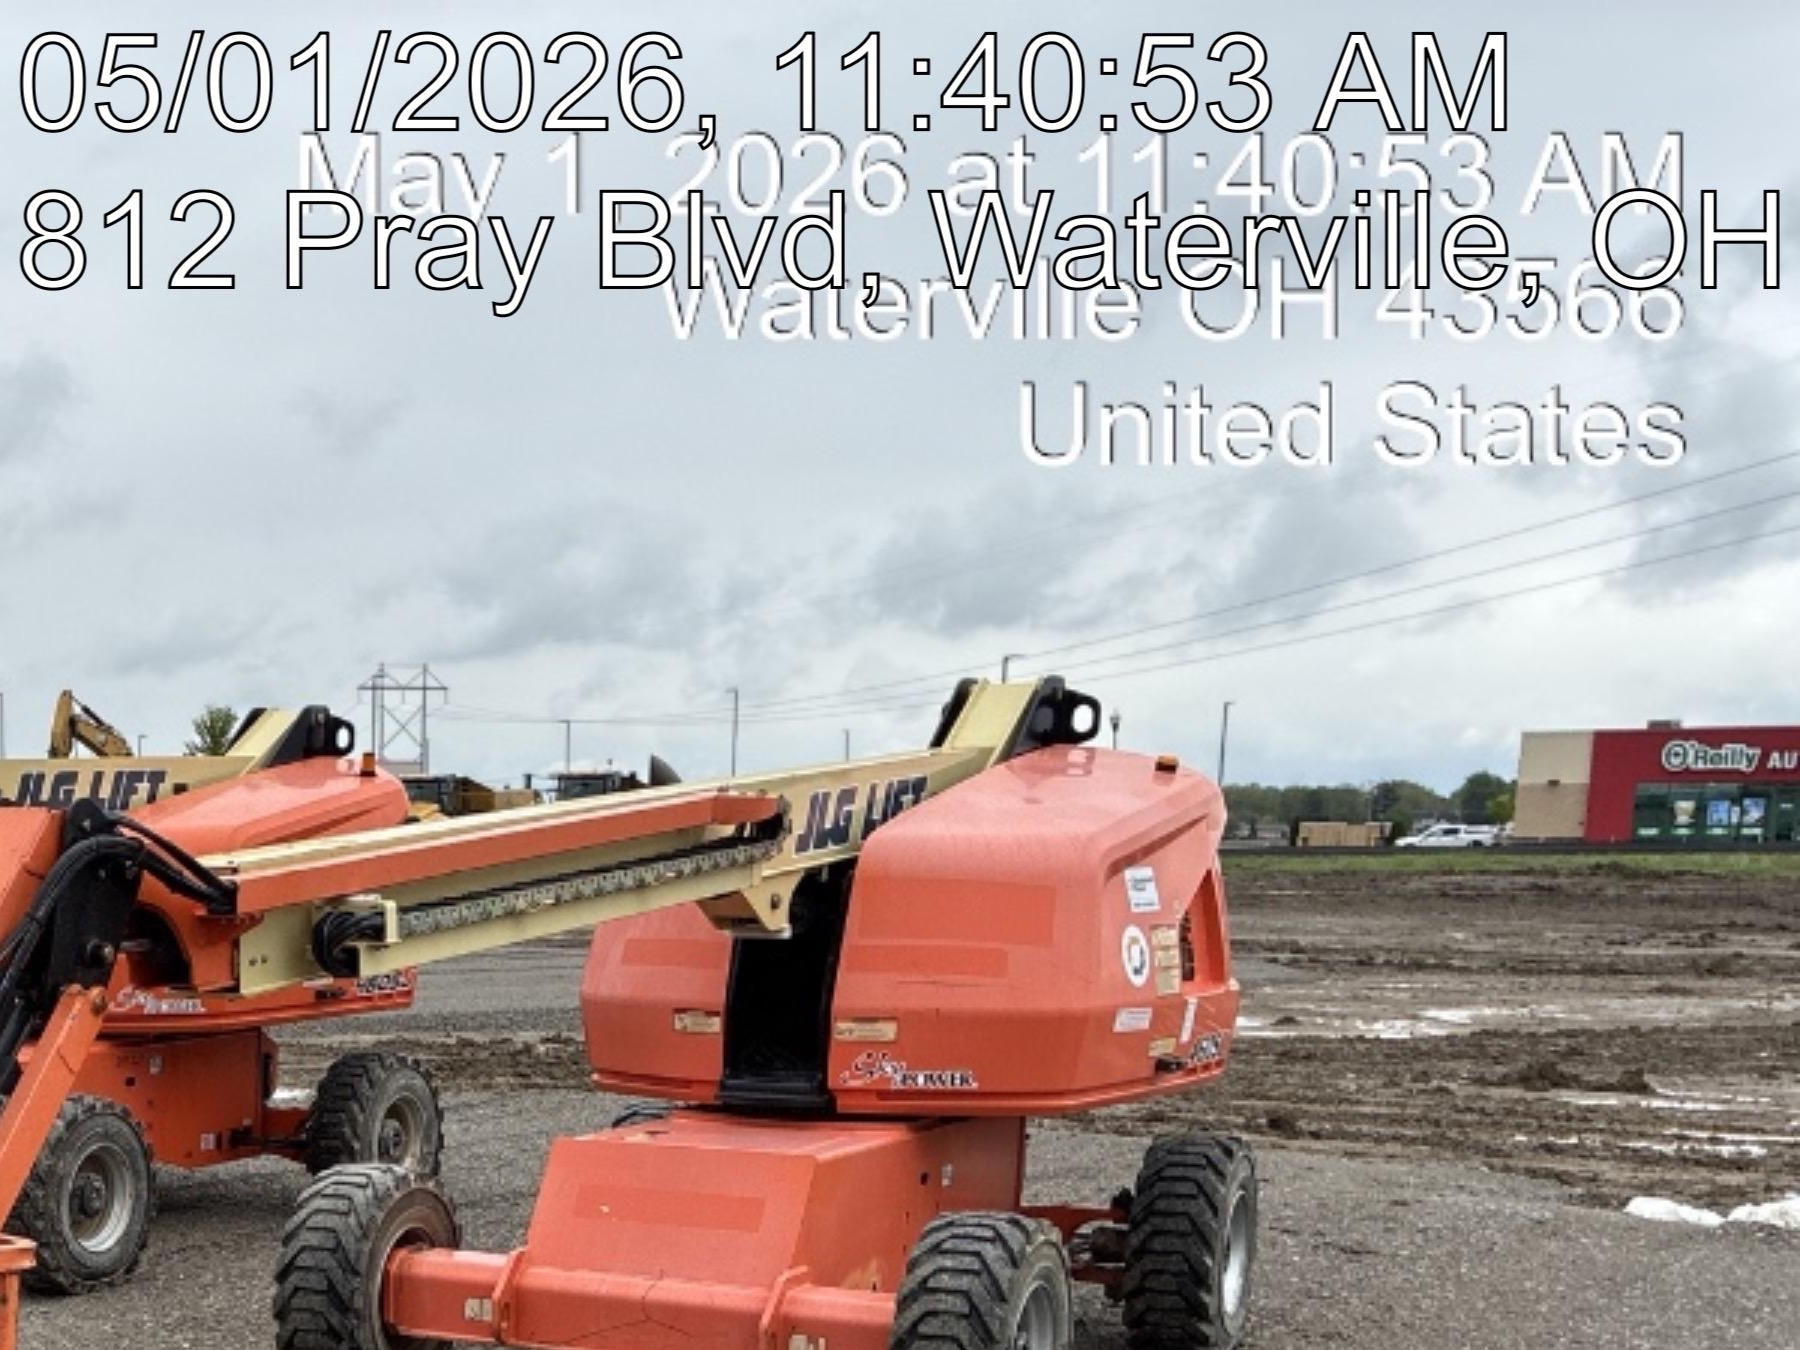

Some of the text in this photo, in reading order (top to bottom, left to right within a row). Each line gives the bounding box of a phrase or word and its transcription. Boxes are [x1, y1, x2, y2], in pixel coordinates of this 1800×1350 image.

[89, 768, 168, 812] LIFT
[793, 774, 929, 857] JLG LIFT
